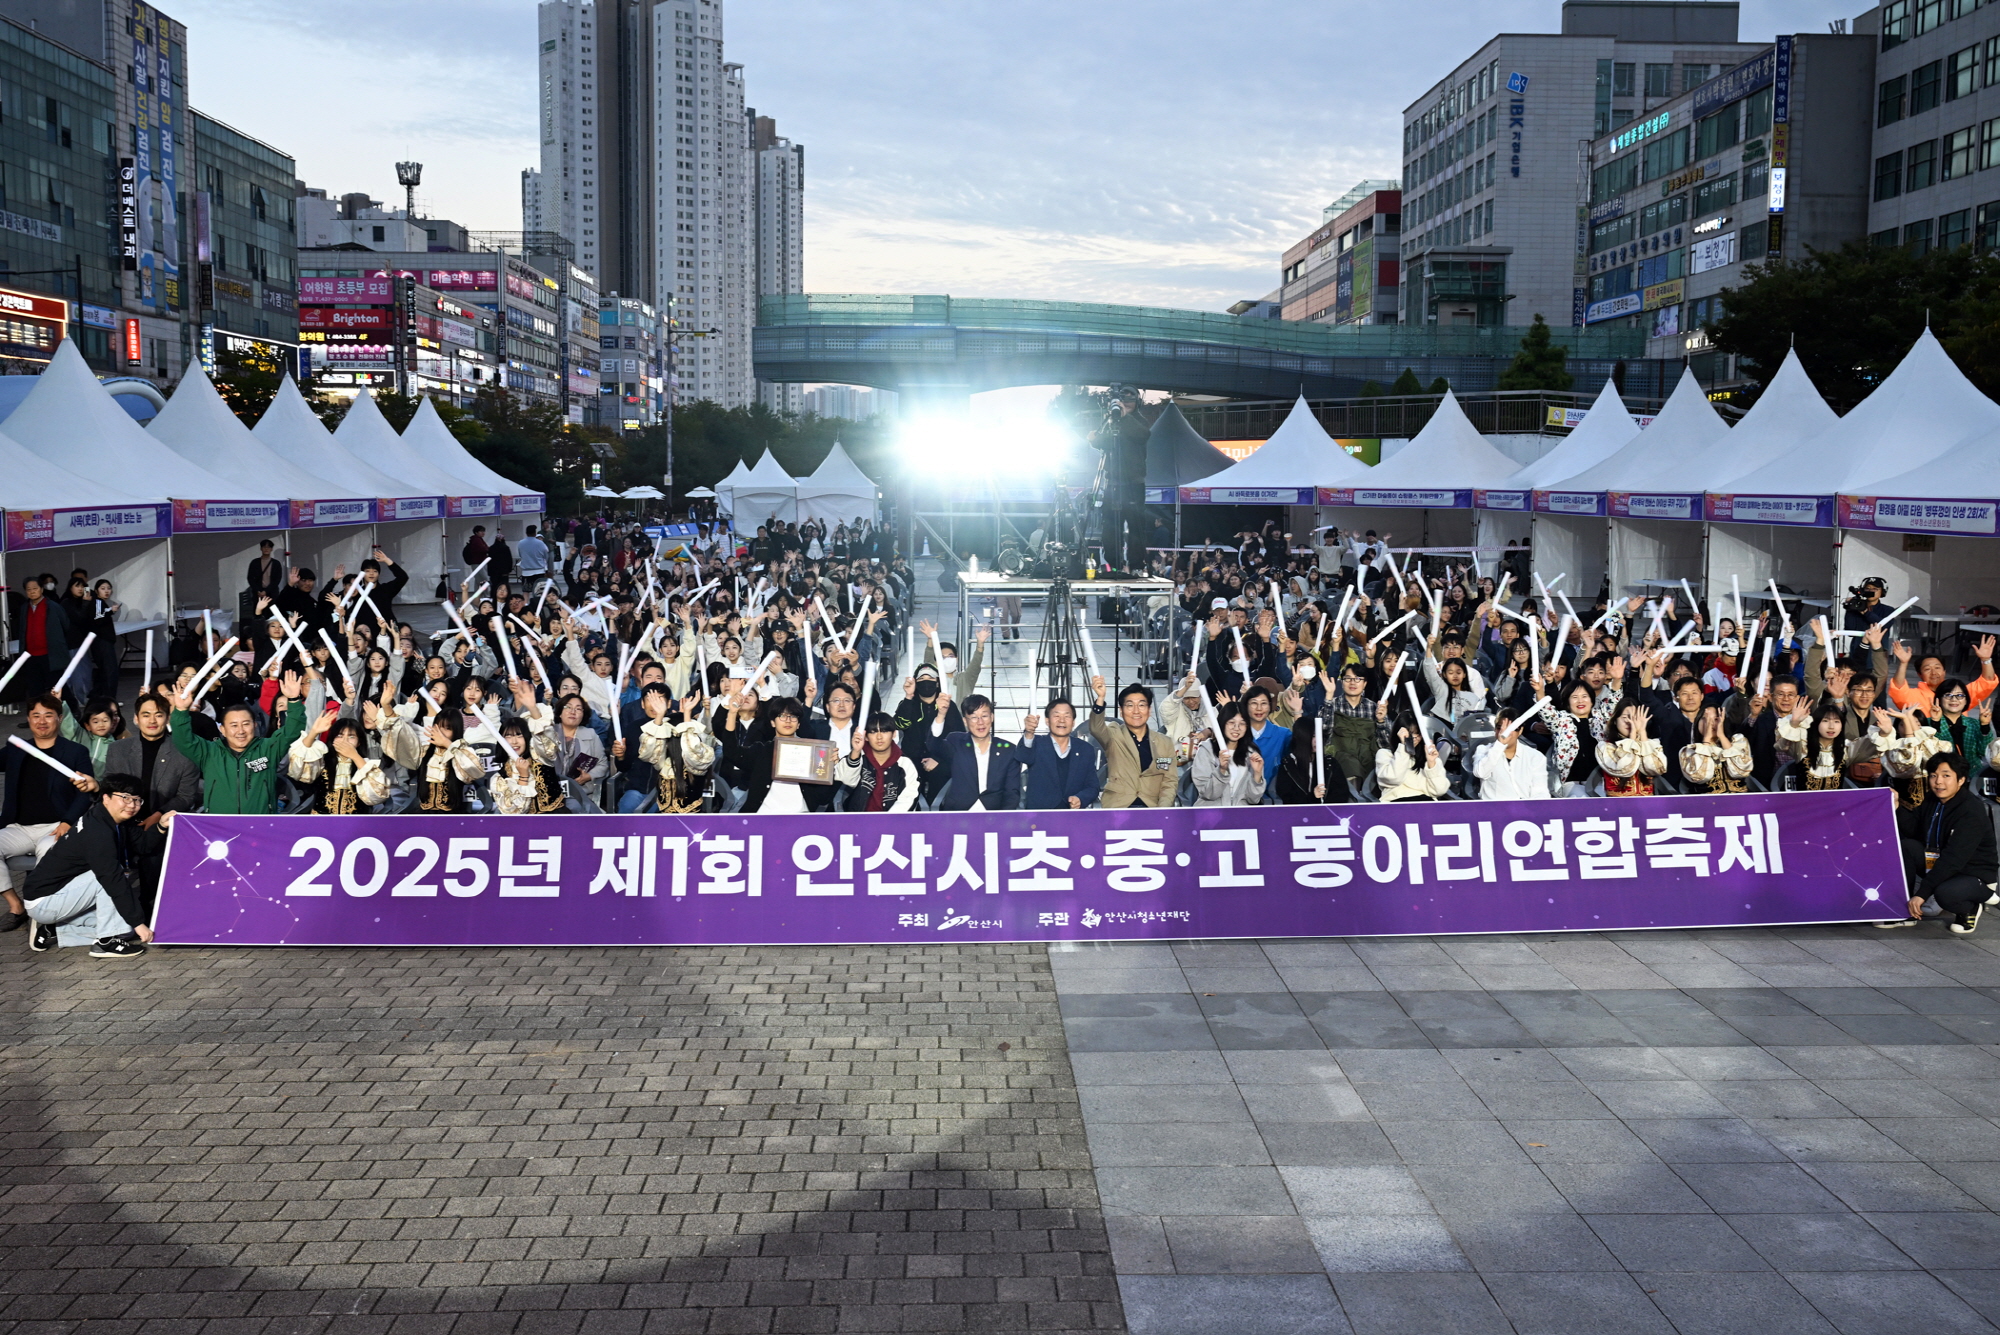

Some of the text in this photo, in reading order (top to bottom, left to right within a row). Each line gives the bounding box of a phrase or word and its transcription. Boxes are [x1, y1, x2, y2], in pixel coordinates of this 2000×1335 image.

[134, 3, 147, 85] 가족사랑
[158, 18, 173, 181] 행복지킴 암 검진
[1509, 98, 1525, 128] IBK
[1776, 82, 1787, 116] 박종원
[546, 106, 554, 137] TOWN
[1511, 131, 1521, 177] 기업은행
[1775, 126, 1785, 161] 노래방
[1772, 173, 1783, 206] 보청기
[122, 183, 136, 259] 더베스트 내과
[1705, 239, 1727, 259] 보청기
[305, 281, 388, 295] 어학원 초등부 모집
[431, 272, 474, 285] 미술학원
[333, 313, 380, 327] Brighton
[374, 375, 385, 383] 3F
[105, 513, 123, 525] 역사를
[124, 512, 135, 524] 보는
[136, 511, 142, 524] 눈
[1878, 503, 1896, 516] 환경을
[1910, 505, 1923, 517] 타임
[1952, 506, 1966, 519] 인생
[285, 813, 1784, 898] 2025년 제1회 안산시초·중·고 동아리연합축제
[898, 913, 1003, 929] 주최 안산시
[1038, 910, 1190, 927] 주관 안산시청소년재단
